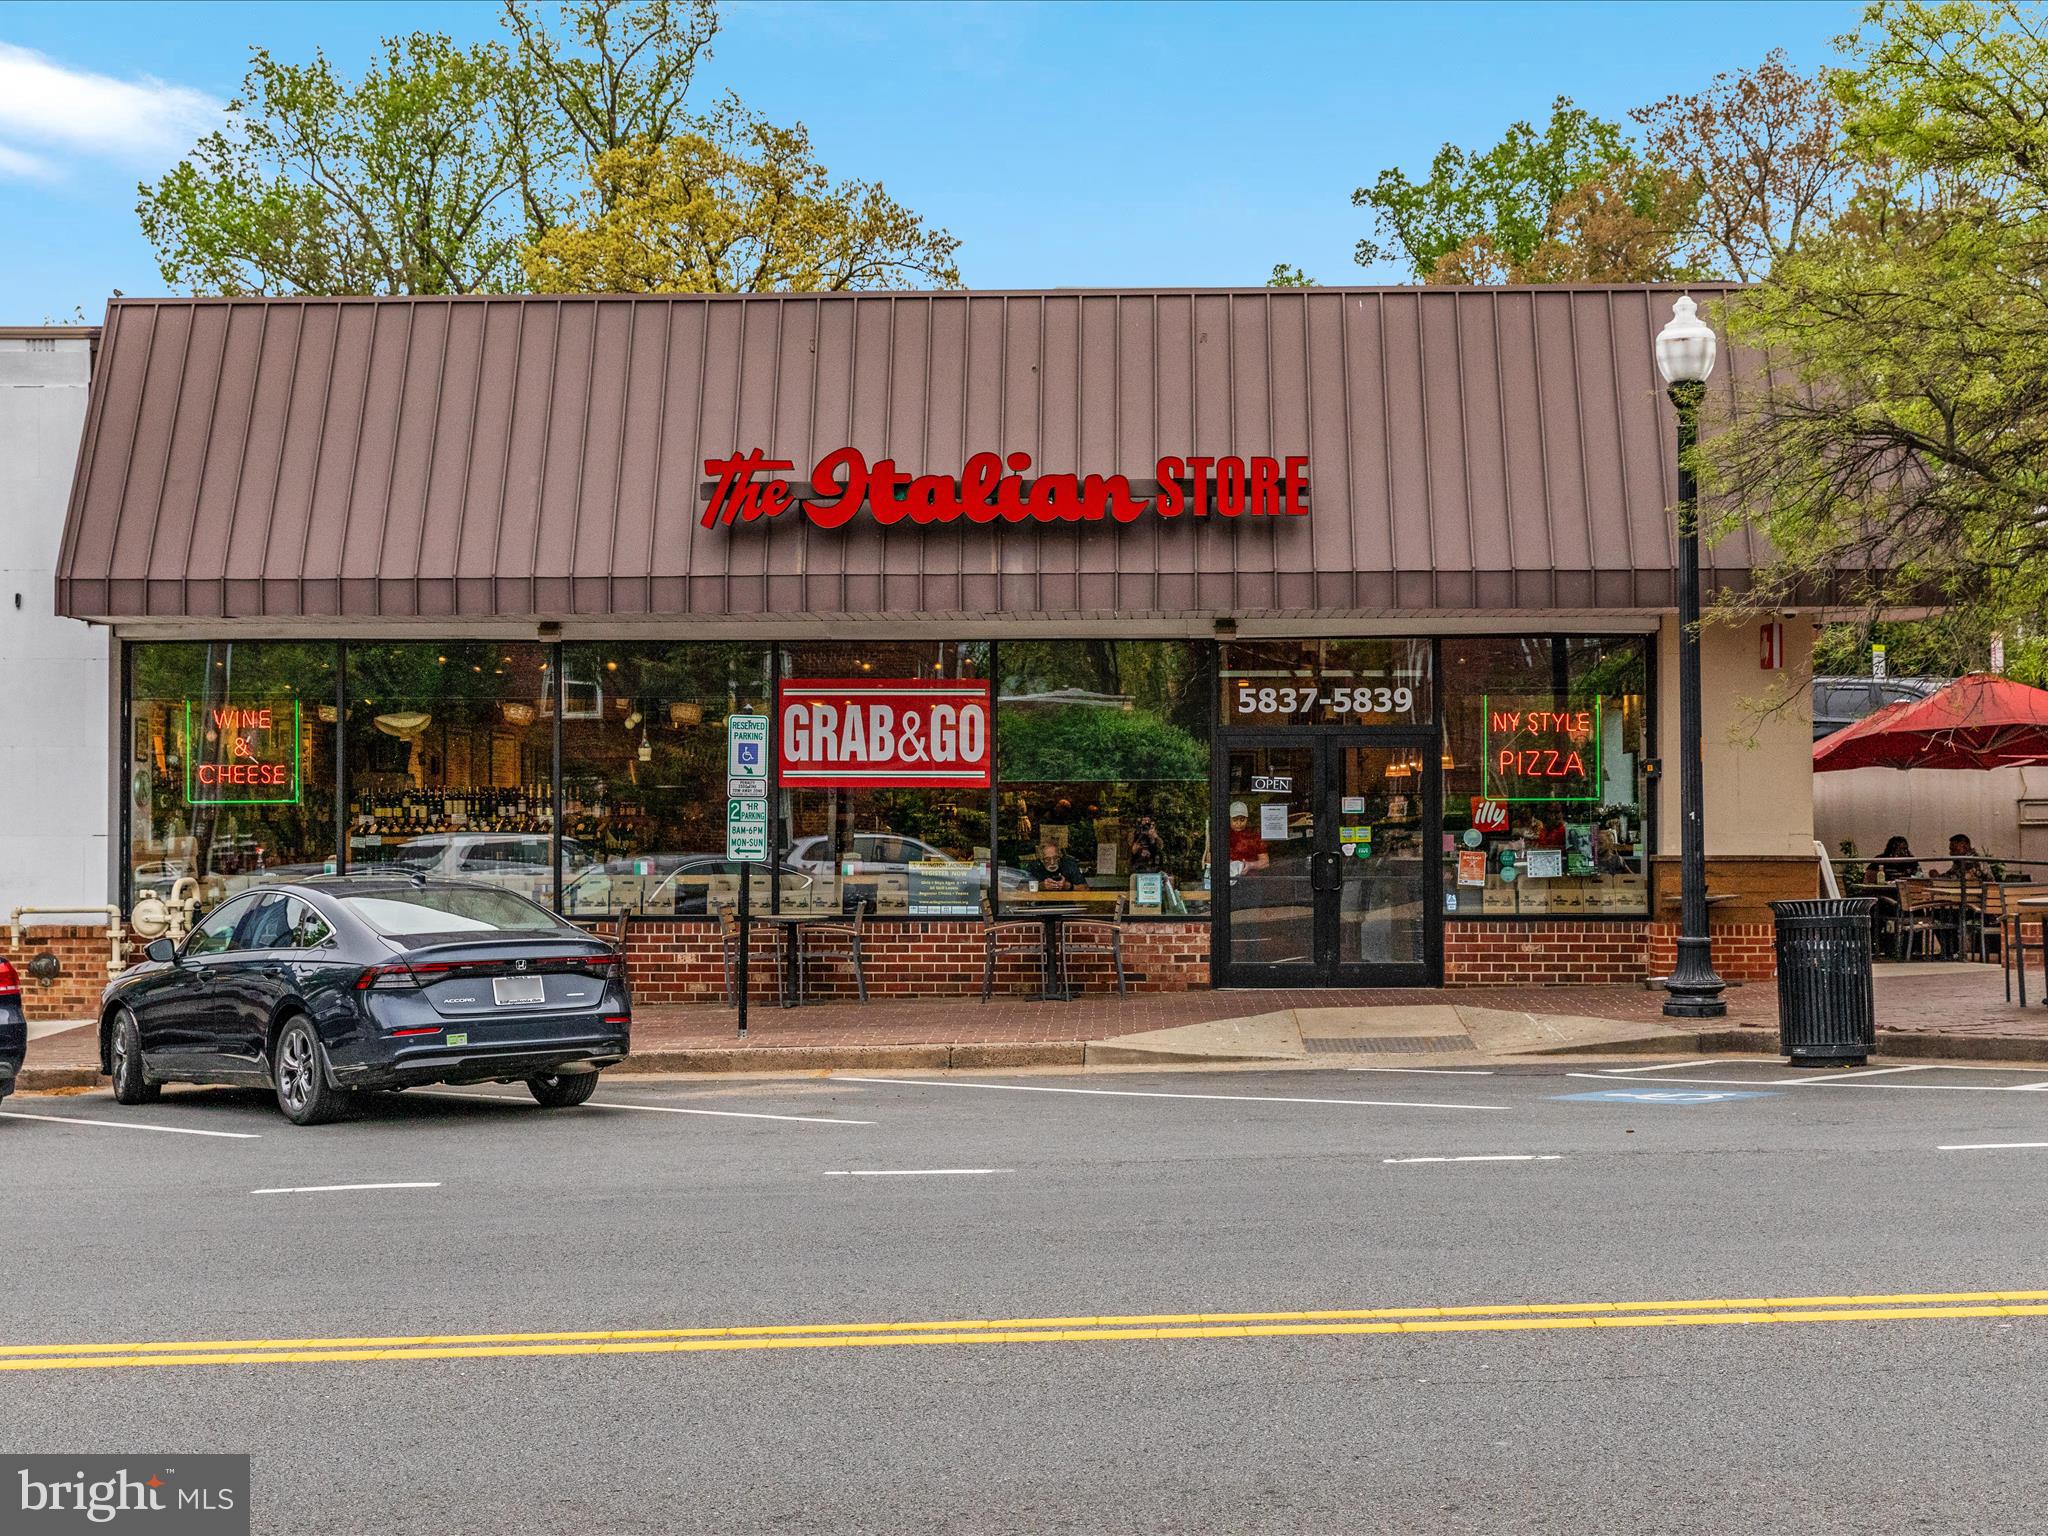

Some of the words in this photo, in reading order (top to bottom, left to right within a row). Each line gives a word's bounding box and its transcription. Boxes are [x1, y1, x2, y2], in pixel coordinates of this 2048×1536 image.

[700, 447, 795, 530] The
[802, 446, 1150, 529] Italian
[1155, 455, 1309, 517] STORE
[1238, 687, 1413, 713] 5837-5839
[213, 709, 272, 729] WINE
[732, 721, 765, 730] RESERVED
[1493, 711, 1521, 732] NY
[1527, 711, 1590, 734] STYLE
[733, 732, 764, 740] PARKING
[234, 737, 251, 757] &
[1499, 750, 1585, 777] PIZZA
[199, 764, 286, 785] CHEESE
[1255, 778, 1289, 790] OPEN
[730, 802, 740, 820] 2
[741, 811, 765, 820] PARKING
[1475, 801, 1506, 829] illy
[731, 826, 763, 834] 8AM-6PM
[731, 838, 763, 847] MON-SUN
